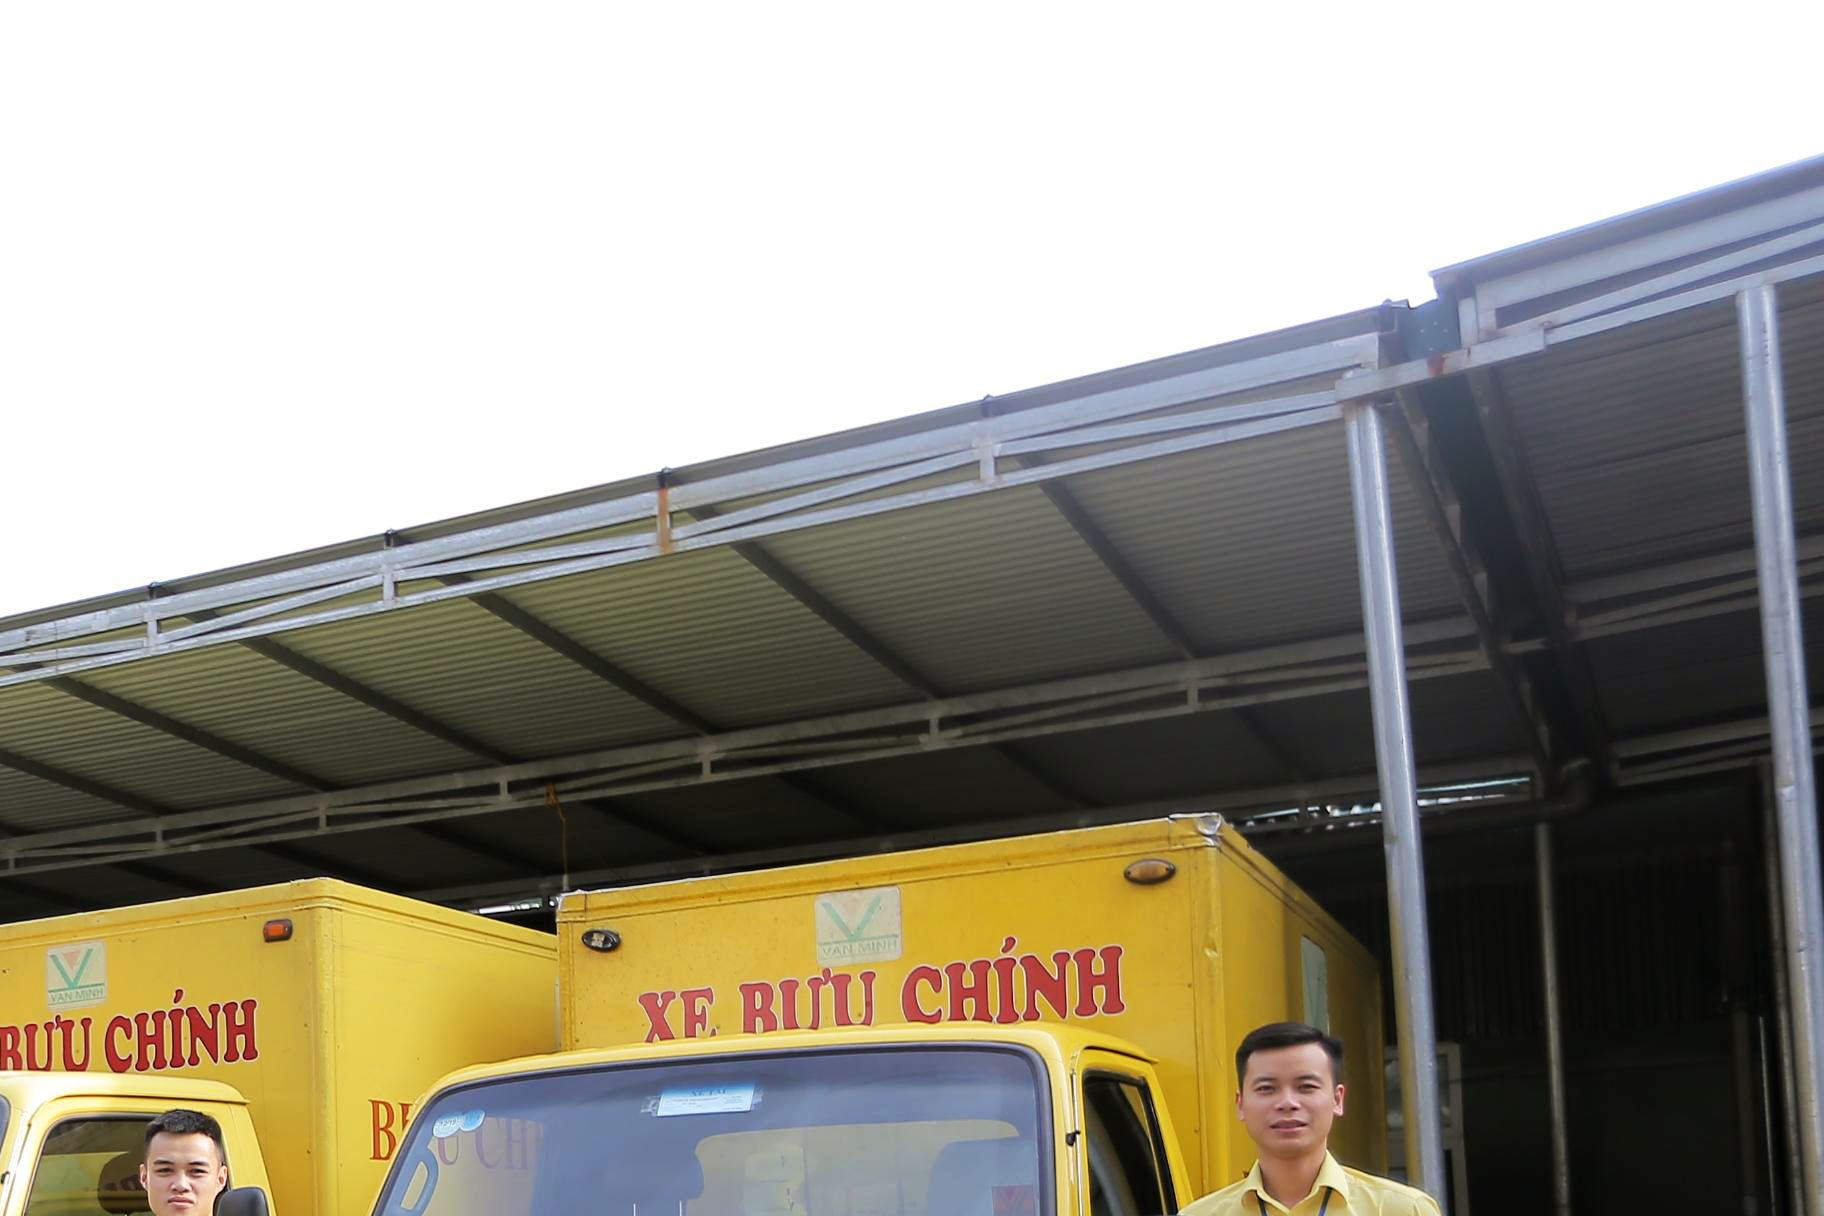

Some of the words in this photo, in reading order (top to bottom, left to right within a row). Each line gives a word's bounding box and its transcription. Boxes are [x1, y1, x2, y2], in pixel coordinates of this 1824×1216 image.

[857, 939, 897, 954] MINH
[104, 988, 259, 1073] CHÍNH
[638, 987, 718, 1043] XE
[738, 967, 877, 1035] BƯU
[901, 936, 1126, 1025] CHÍNH
